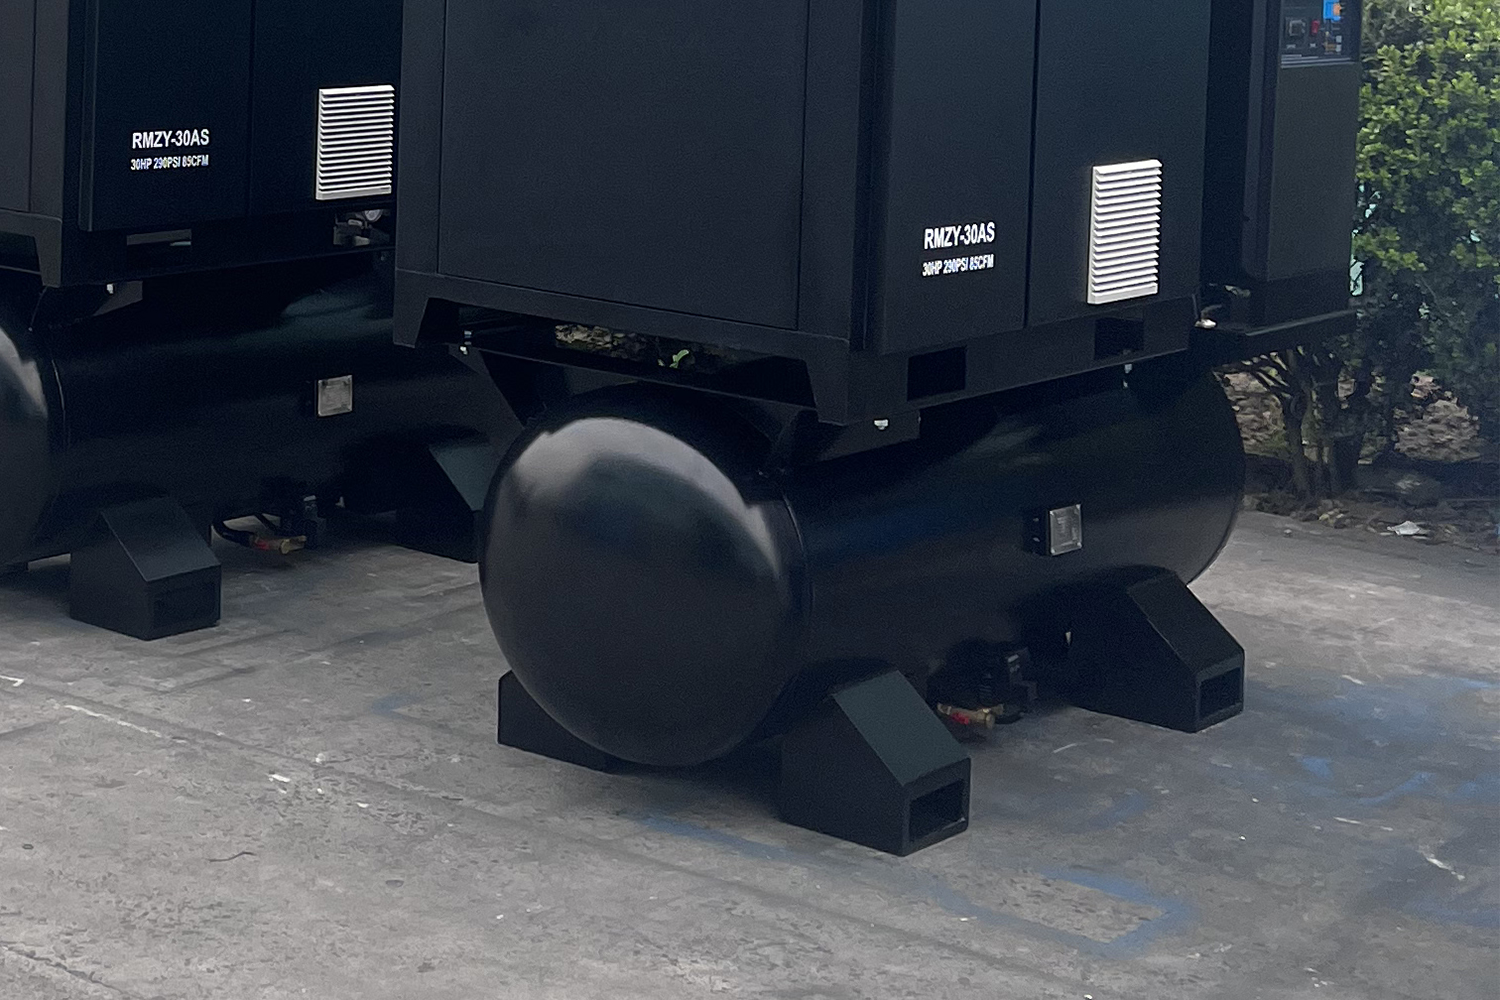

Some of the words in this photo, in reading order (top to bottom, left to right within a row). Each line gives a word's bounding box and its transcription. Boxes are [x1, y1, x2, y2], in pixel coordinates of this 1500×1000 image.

[132, 128, 210, 149] RMZY-30AS
[130, 157, 152, 171] 30HP
[153, 156, 181, 170] 290PSI
[924, 221, 996, 250] RMZY-30AS
[922, 260, 943, 277] 30HP
